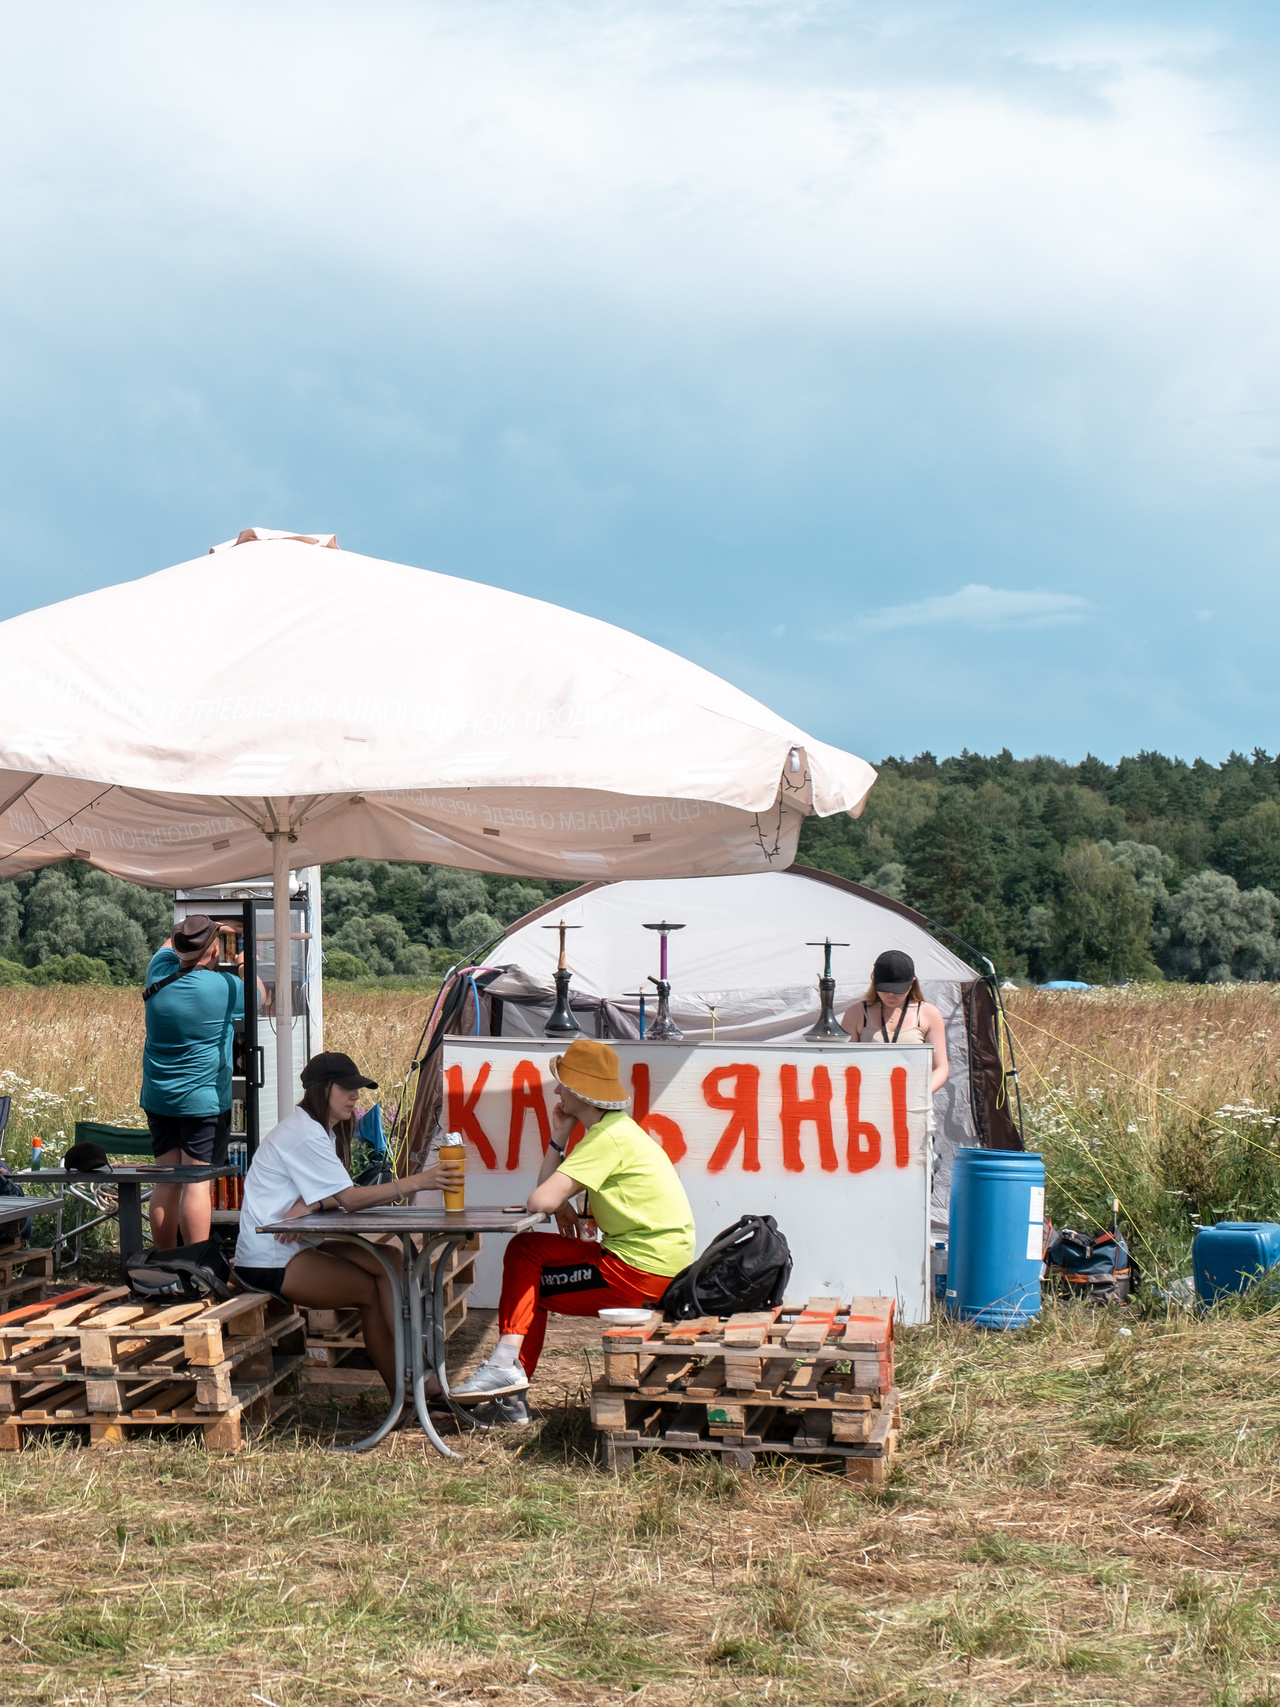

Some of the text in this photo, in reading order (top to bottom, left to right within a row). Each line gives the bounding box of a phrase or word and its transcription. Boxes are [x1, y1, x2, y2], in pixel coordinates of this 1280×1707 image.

[157, 693, 329, 728] ПОТРЕБЛЕНИЯ
[333, 696, 518, 738] АЛКОГОЛЬНОЙ
[523, 703, 681, 738] ПРОДУКЦИИ
[445, 1059, 910, 1174] КАЬЯНЫ
[570, 1268, 592, 1283] RIP
